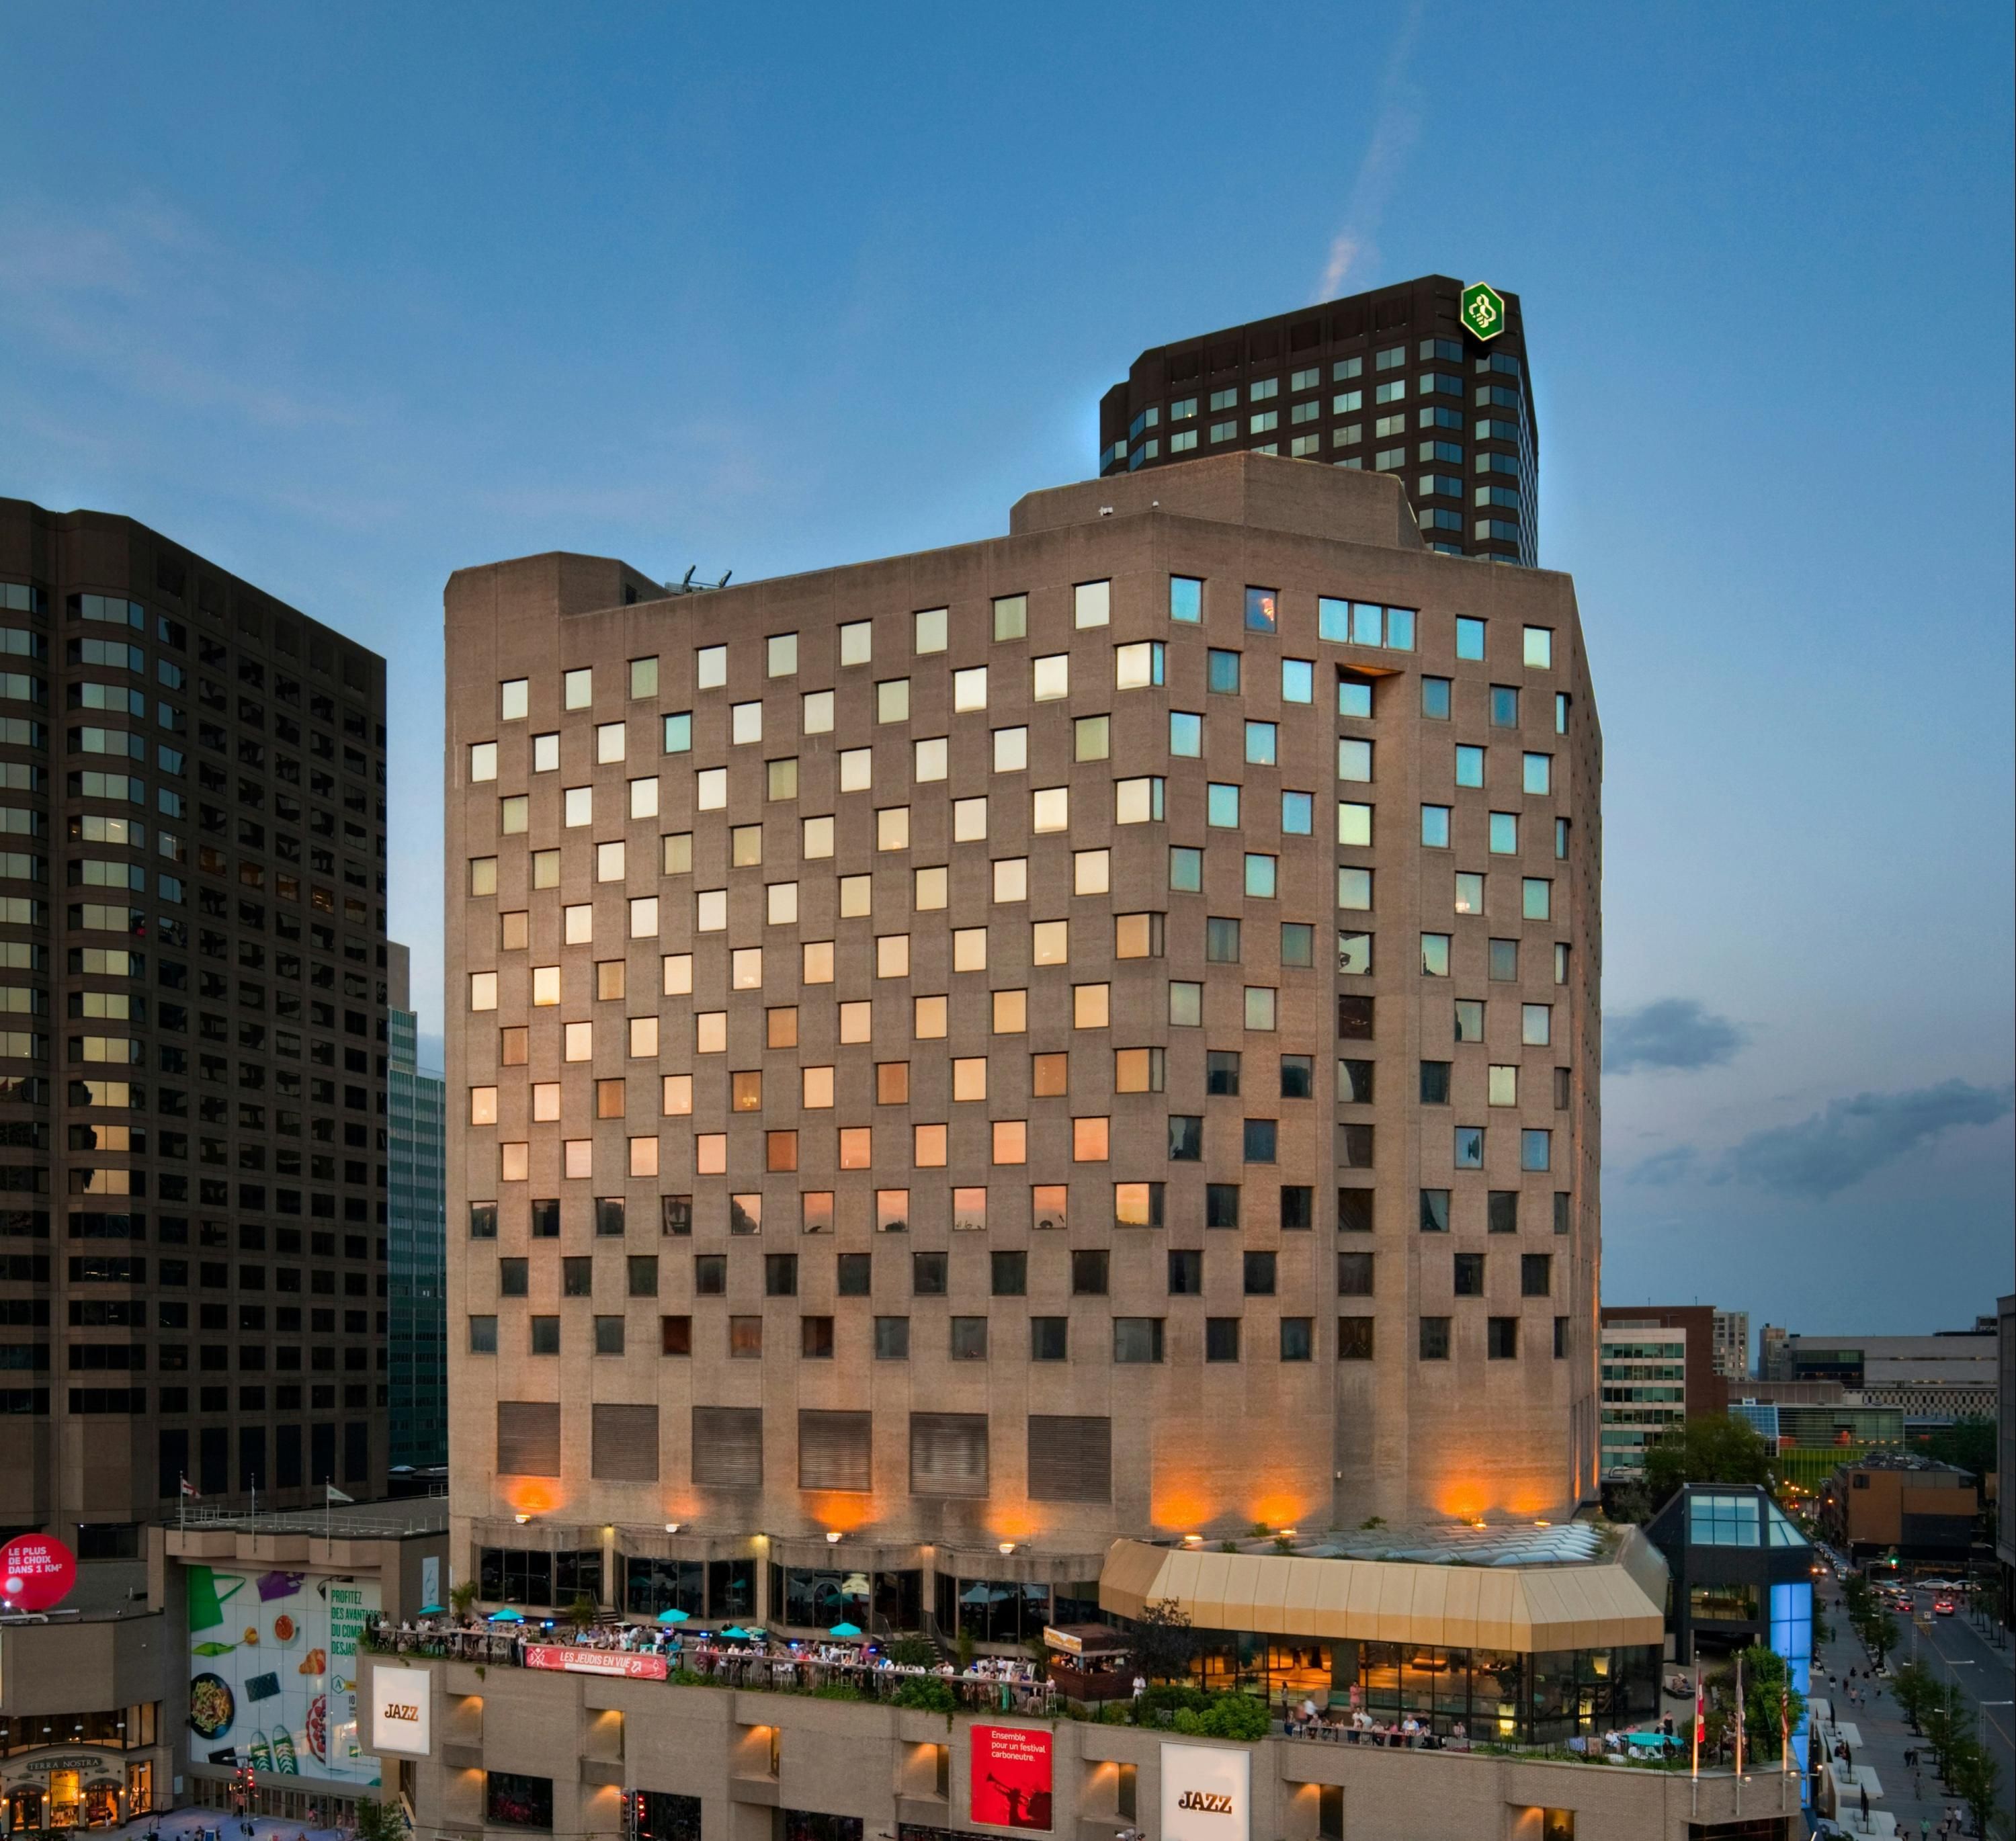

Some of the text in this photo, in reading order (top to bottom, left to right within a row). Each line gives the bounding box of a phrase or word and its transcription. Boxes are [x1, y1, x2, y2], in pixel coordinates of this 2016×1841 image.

[8, 1547, 46, 1556] LE PLUS
[8, 1555, 51, 1565] DE CHOIX
[8, 1566, 34, 1574] DANS
[36, 1565, 42, 1573] 1
[331, 1590, 362, 1604] PROFITEZ
[331, 1607, 344, 1620] DES
[331, 1623, 341, 1637] DU
[560, 1652, 632, 1668] LES JEUDIS EN VUE
[384, 1703, 419, 1721] JAZZ
[991, 1731, 1026, 1742] Ensemble
[1020, 1743, 1046, 1753] festival
[991, 1751, 1036, 1762] carboneutre.
[29, 1759, 99, 1770] TERRA NOSTRA
[1178, 1791, 1232, 1814] JAZZ
